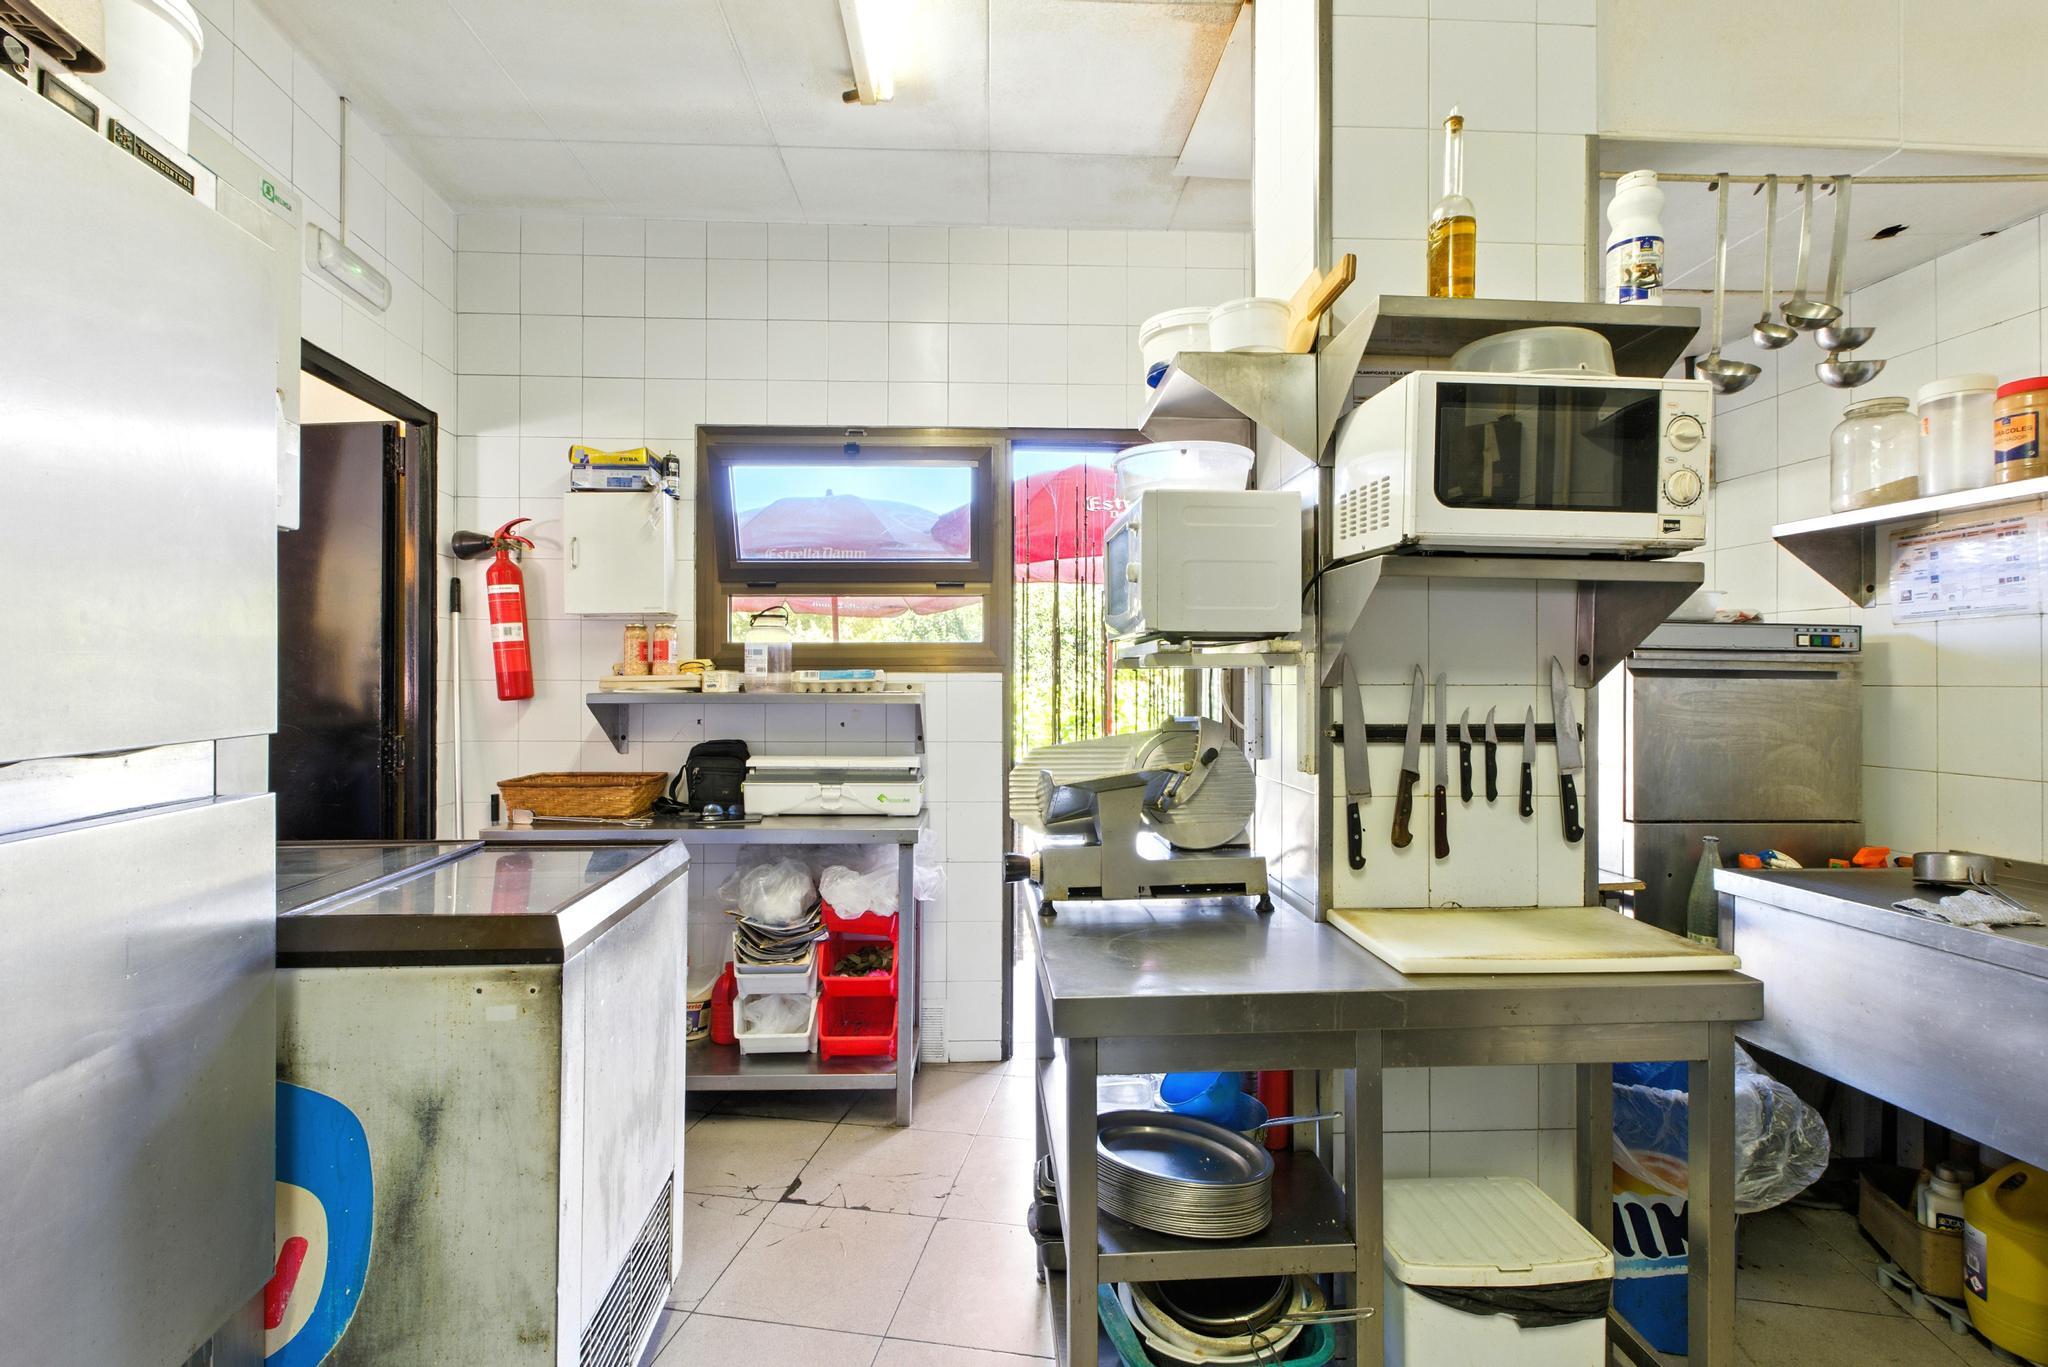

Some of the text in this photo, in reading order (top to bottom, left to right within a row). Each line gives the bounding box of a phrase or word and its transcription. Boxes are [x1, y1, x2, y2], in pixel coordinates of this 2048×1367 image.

[138, 144, 192, 189] TECNICONTROL
[765, 546, 867, 559] Estrella Damm
